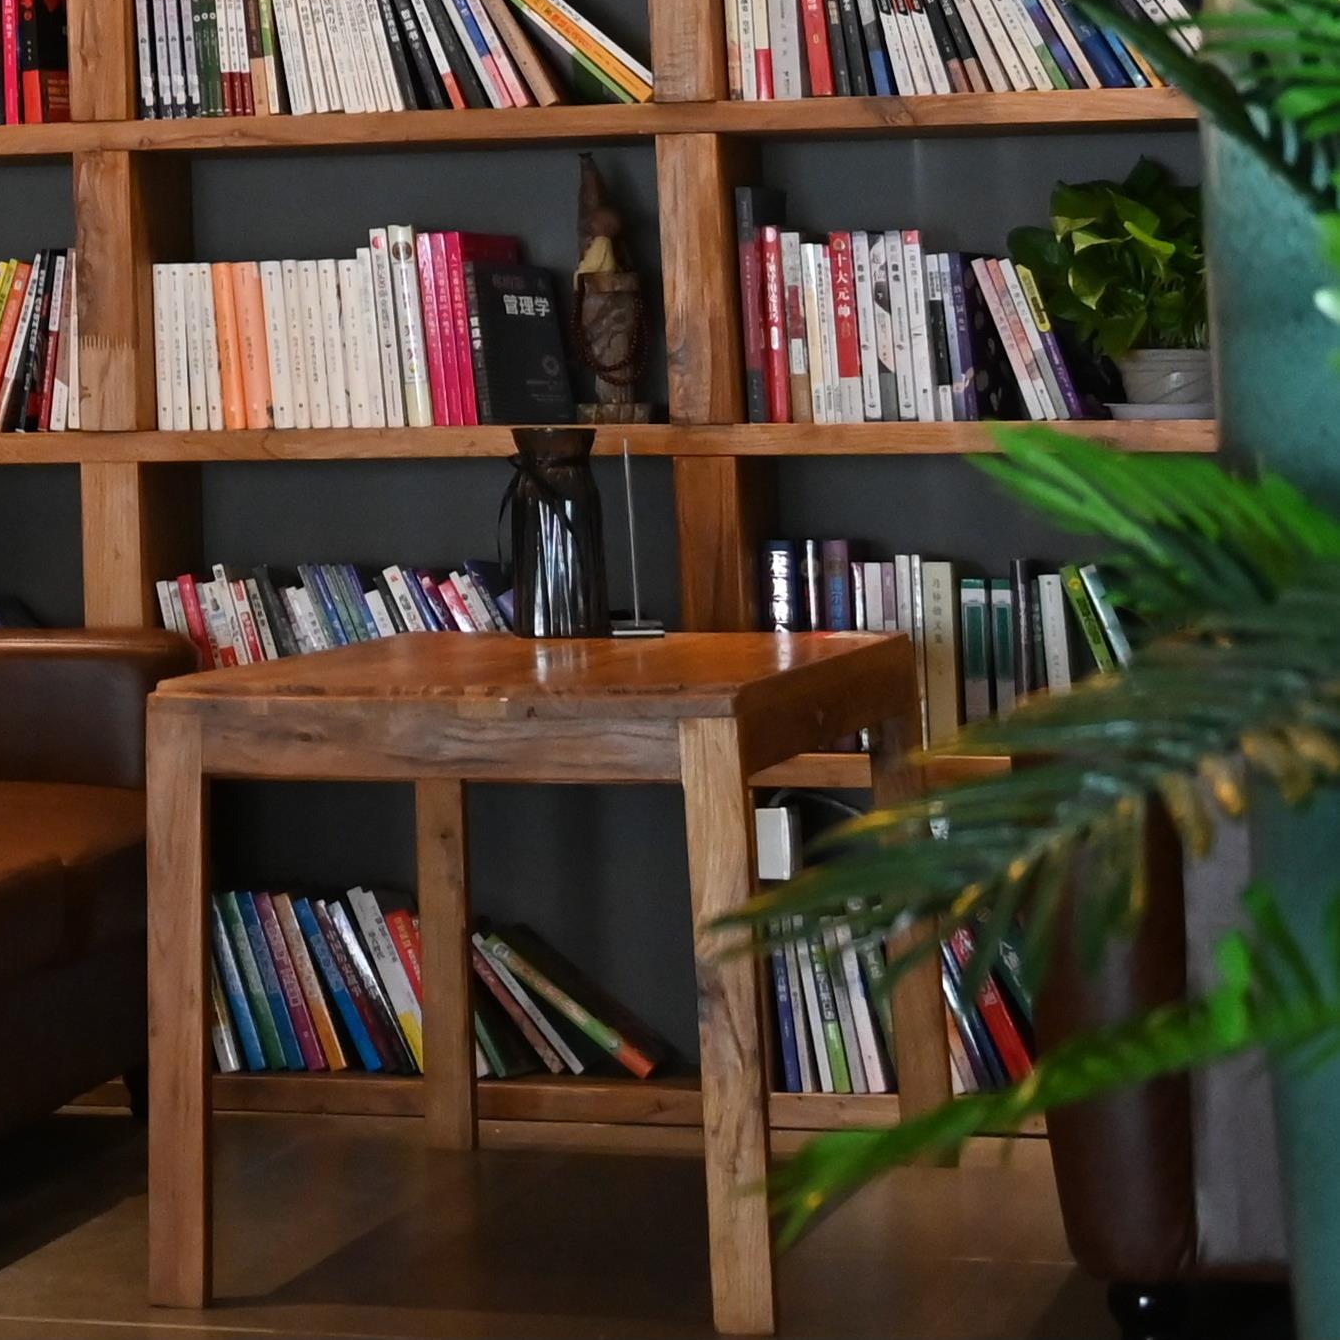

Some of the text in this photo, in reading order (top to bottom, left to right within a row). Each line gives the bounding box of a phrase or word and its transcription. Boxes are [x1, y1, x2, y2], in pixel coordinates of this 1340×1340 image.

[502, 293, 550, 317] 管理学
[835, 254, 851, 320] 十大元帅
